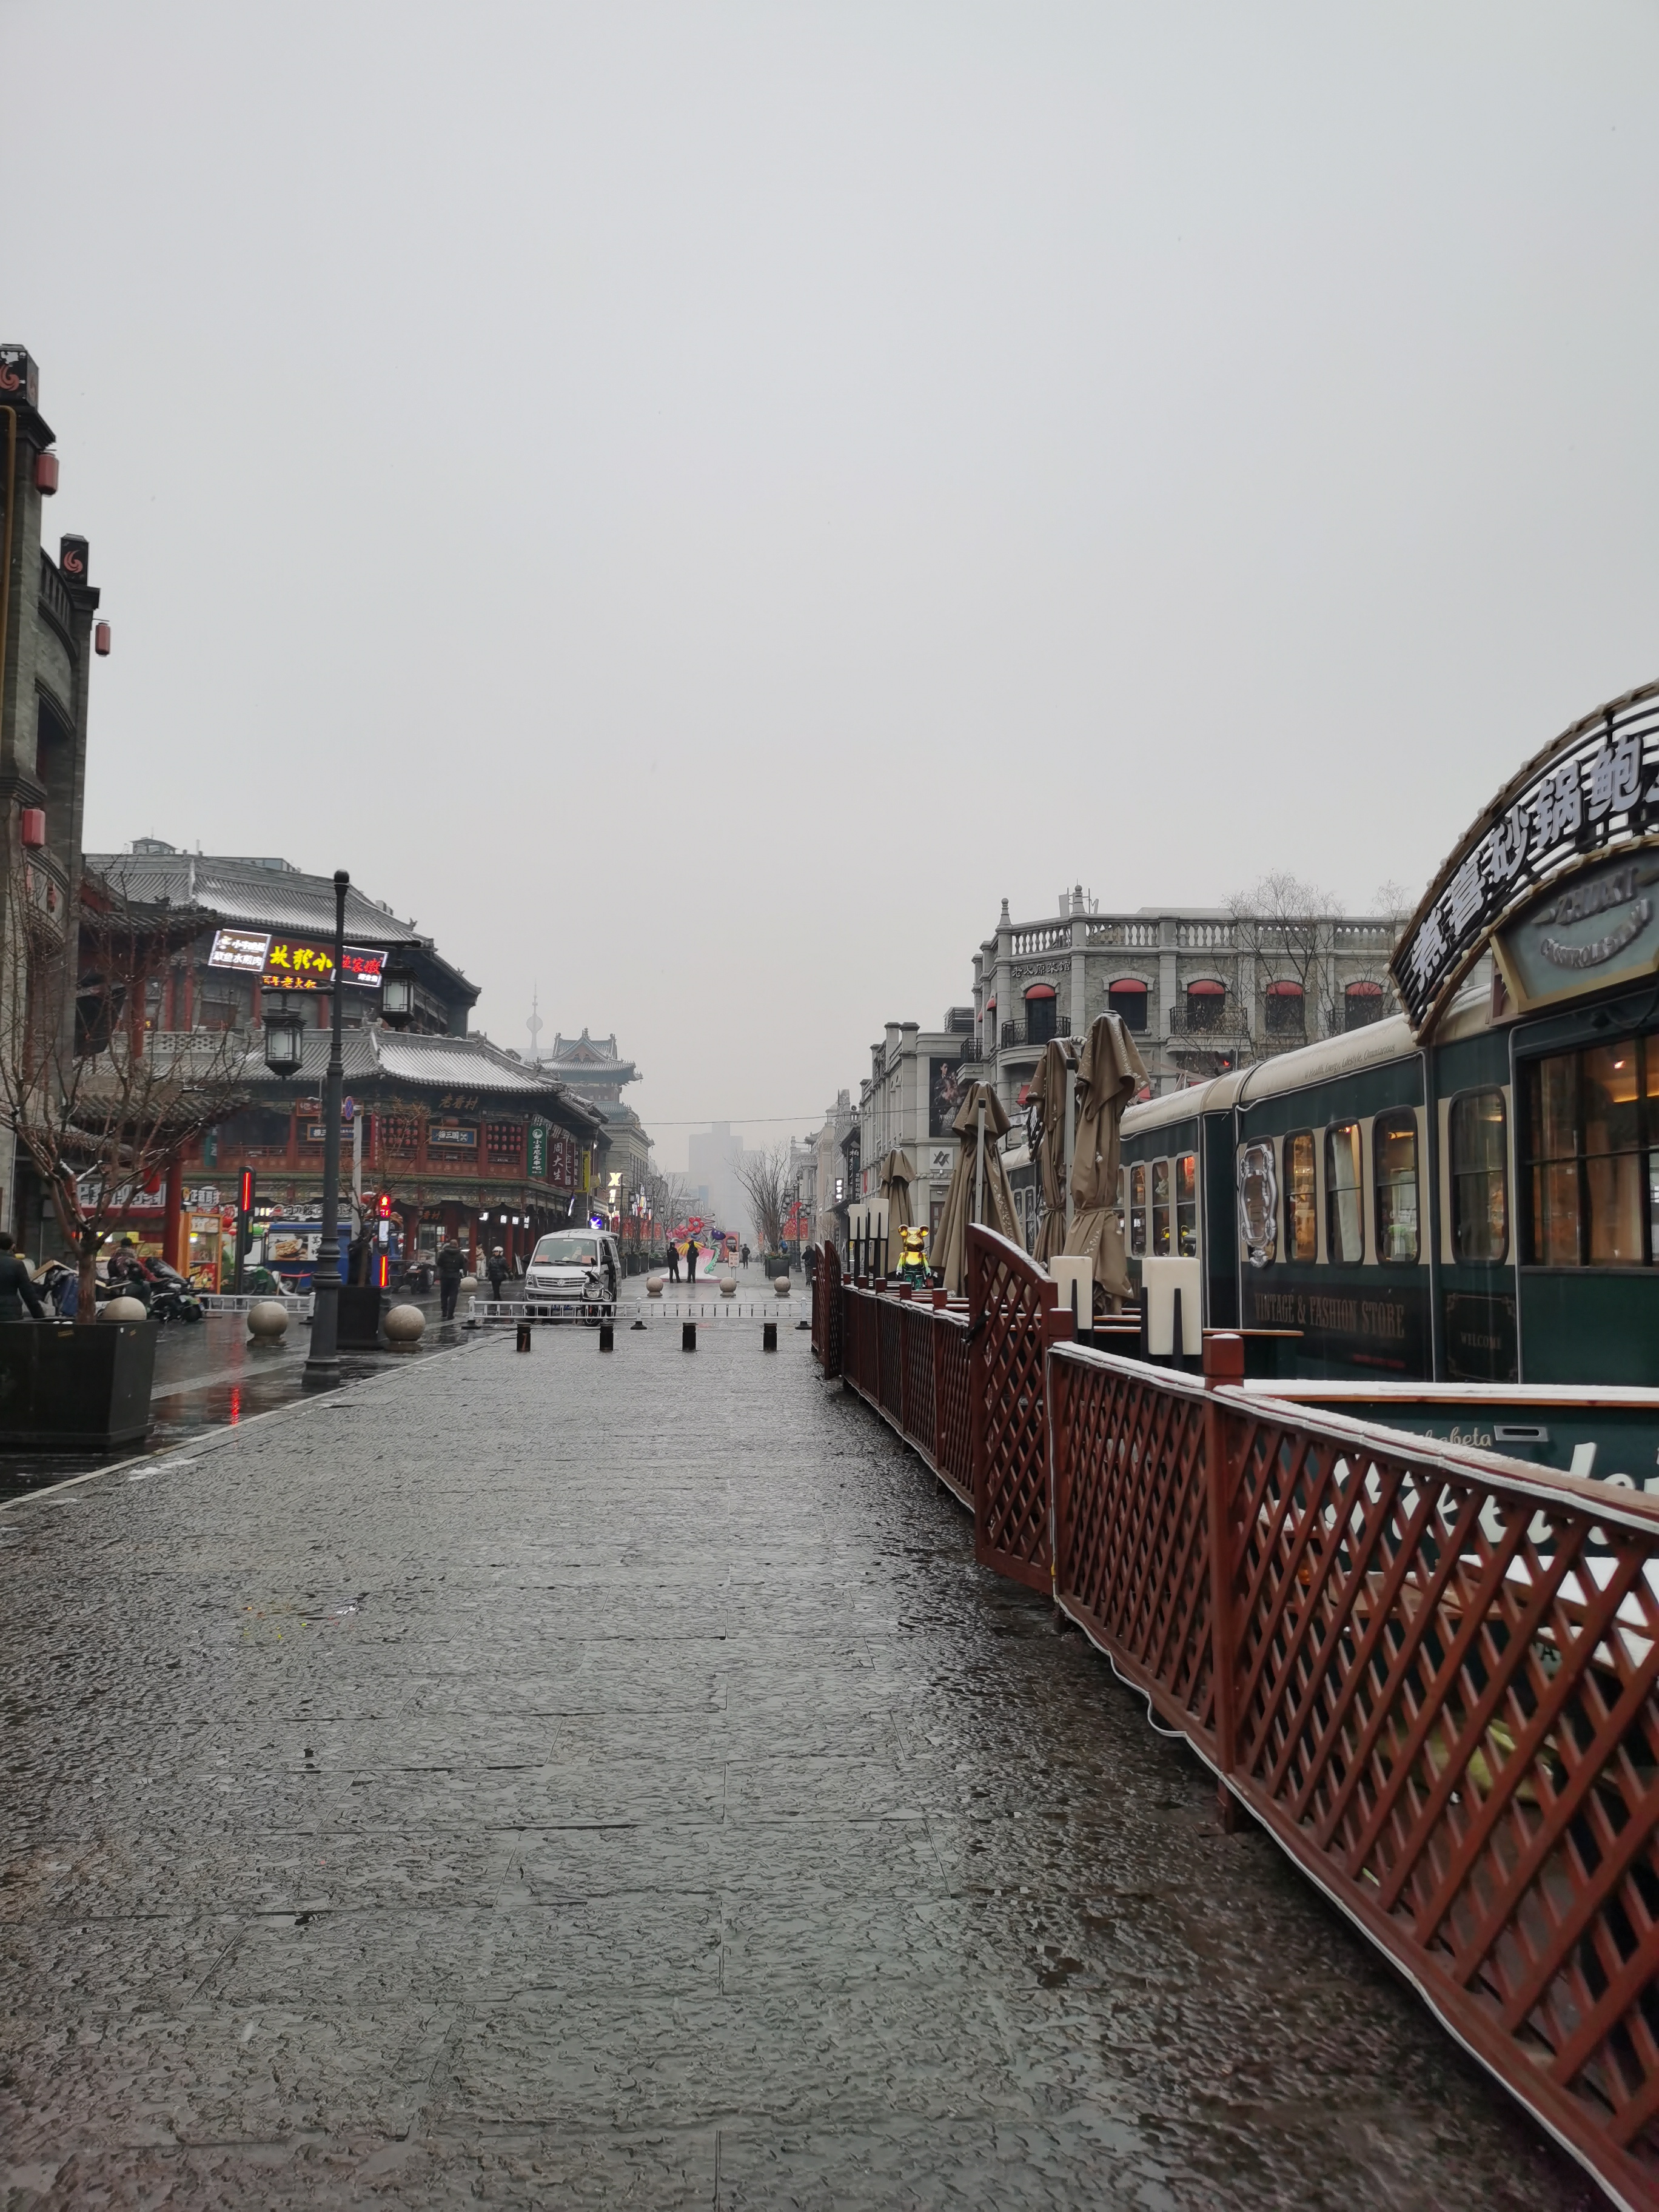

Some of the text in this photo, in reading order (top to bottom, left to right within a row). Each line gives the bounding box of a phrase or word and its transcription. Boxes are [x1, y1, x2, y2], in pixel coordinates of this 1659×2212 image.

[1412, 734, 1659, 993] 煮喜砂锅鲍
[1012, 961, 1071, 977] 老太原菜馆
[438, 1093, 478, 1110] 老香村
[552, 1142, 563, 1180] 周大生
[1255, 1293, 1405, 1339] VINTAGE & FASHION STORE
[1461, 1331, 1503, 1350] WELCOME
